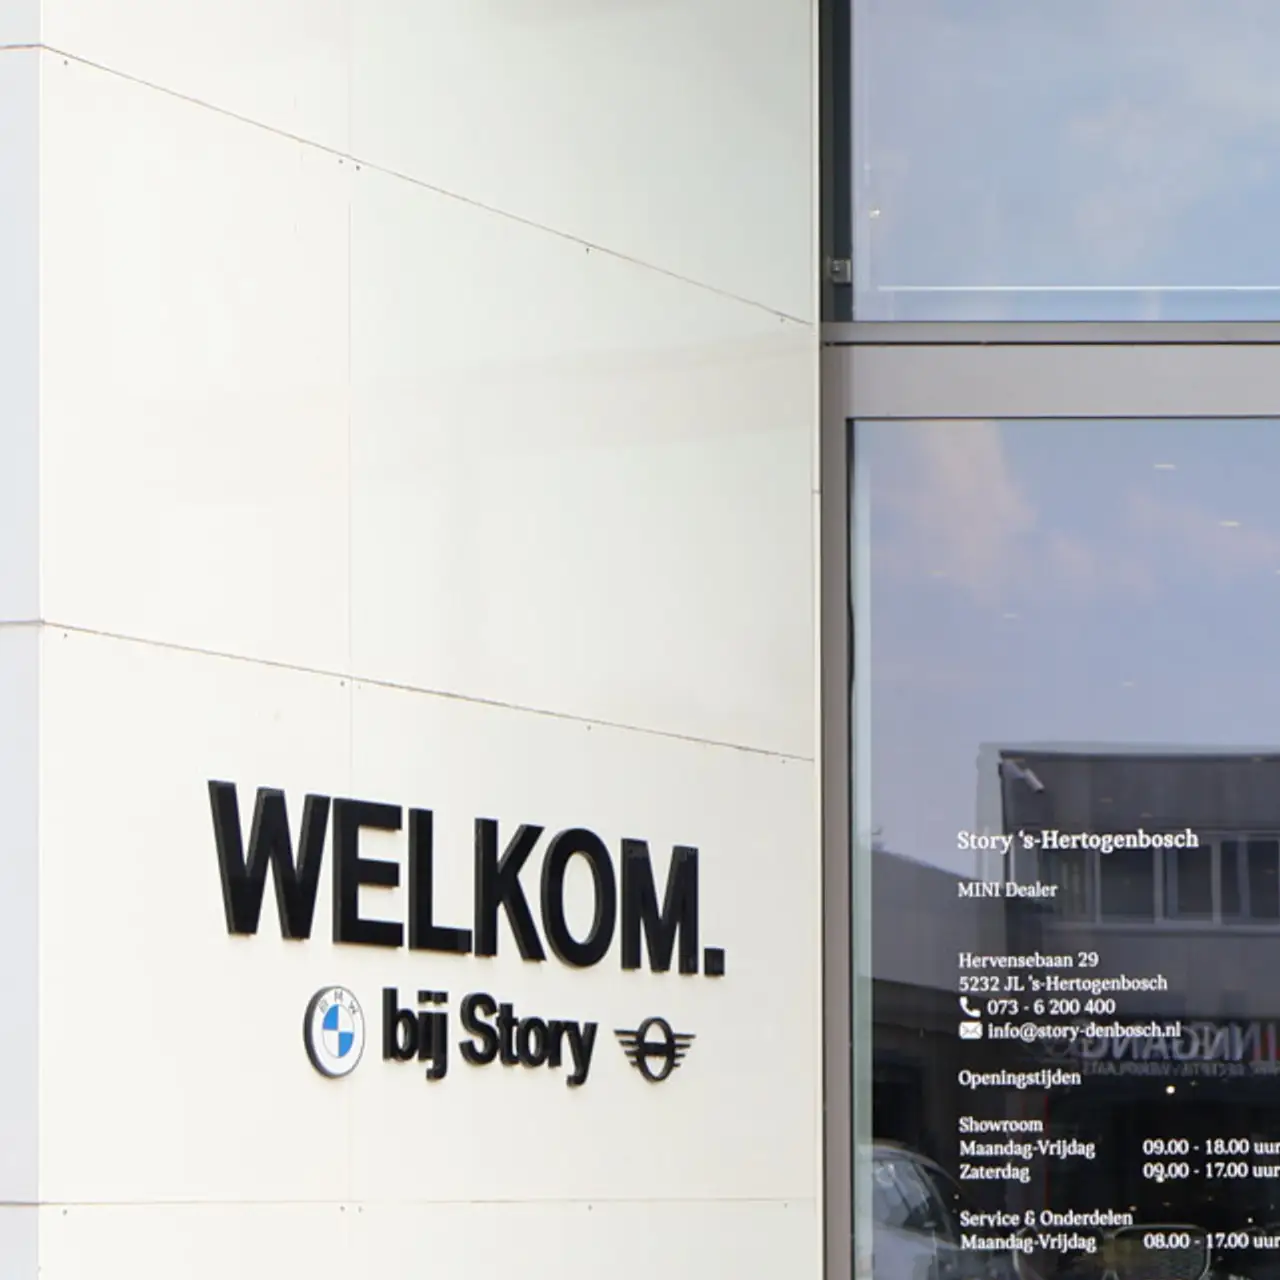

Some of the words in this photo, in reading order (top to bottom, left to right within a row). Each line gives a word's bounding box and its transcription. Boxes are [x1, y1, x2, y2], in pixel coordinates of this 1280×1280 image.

[957, 831, 1013, 855] Story
[209, 780, 725, 977] WELKOM.
[957, 882, 1001, 898] MINI
[1005, 879, 1058, 898] Dealer
[958, 951, 1074, 968] Hervensebaan
[1078, 952, 1100, 968] 29
[958, 975, 1000, 993] 5232
[1004, 975, 1025, 994] JL
[987, 999, 1019, 1015] 073
[1034, 999, 1044, 1015] 6
[1049, 998, 1080, 1015] 200
[1084, 998, 1116, 1015] 400
[383, 988, 448, 1080] bij
[460, 993, 598, 1086] Story
[987, 1020, 1182, 1043] info@story-denbosch.nl
[957, 1068, 1082, 1090] Openingstijden
[958, 1116, 1044, 1133] Showroom
[959, 1138, 1096, 1160] Maandag-Vrijdag
[1142, 1139, 1190, 1156] 09.00
[1205, 1138, 1250, 1155] 18.00
[959, 1162, 1031, 1183] Zaterdag
[1142, 1162, 1190, 1179] 09.00
[1205, 1162, 1250, 1179] 17.00
[959, 1210, 1020, 1227] Service
[1040, 1208, 1134, 1226] Onderdelen
[959, 1232, 1097, 1253] Maandag-Vrijdag
[1143, 1232, 1190, 1250] 08.00
[1205, 1232, 1250, 1249] 17.00
